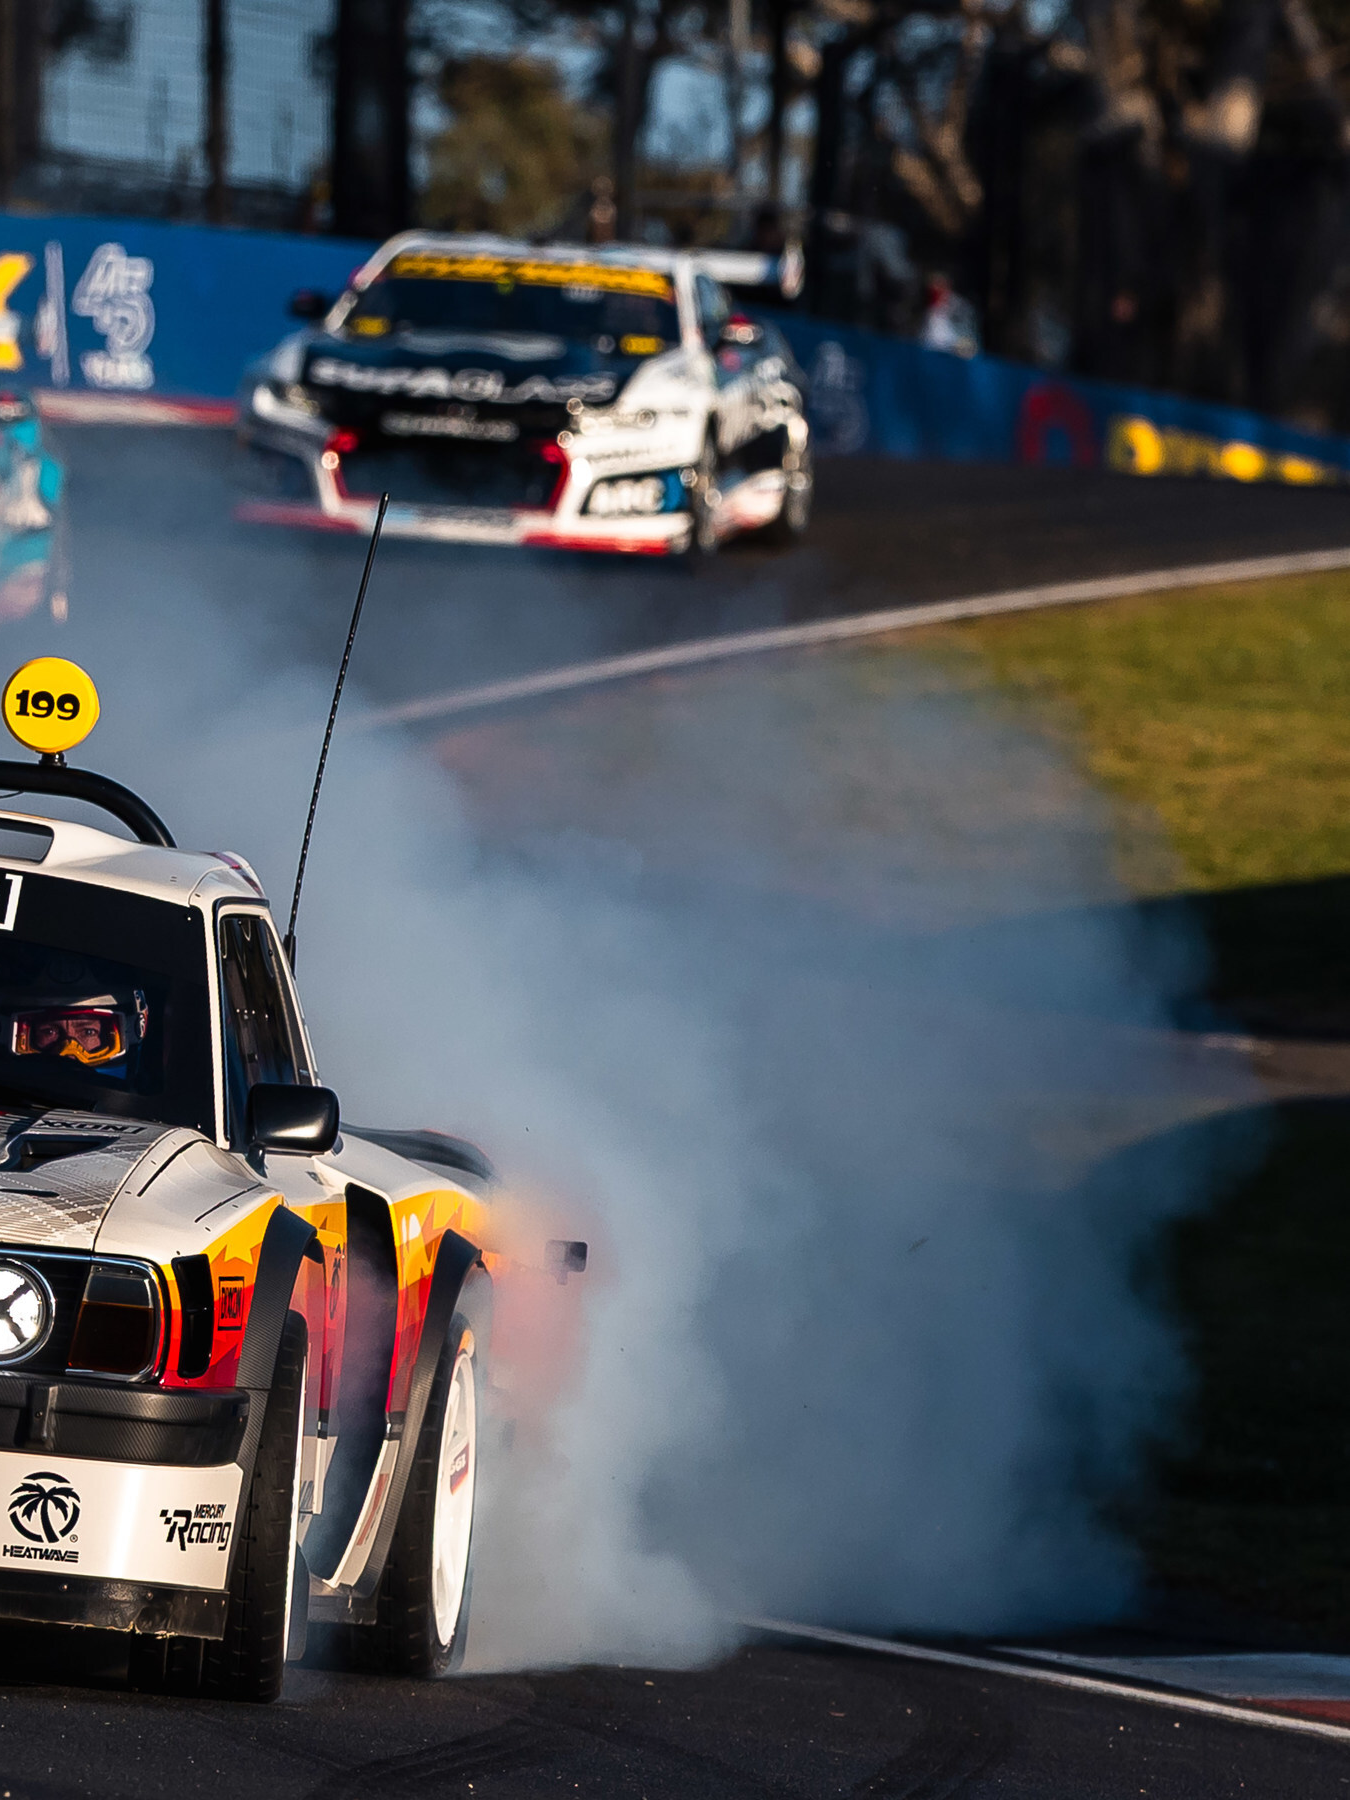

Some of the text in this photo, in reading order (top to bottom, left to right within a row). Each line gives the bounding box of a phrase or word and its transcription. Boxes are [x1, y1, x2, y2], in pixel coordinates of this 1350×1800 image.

[14, 689, 81, 721] 199
[193, 1503, 227, 1519] MERCURY
[165, 1509, 232, 1551] Racing
[2, 1544, 80, 1564] HEATWAVE
